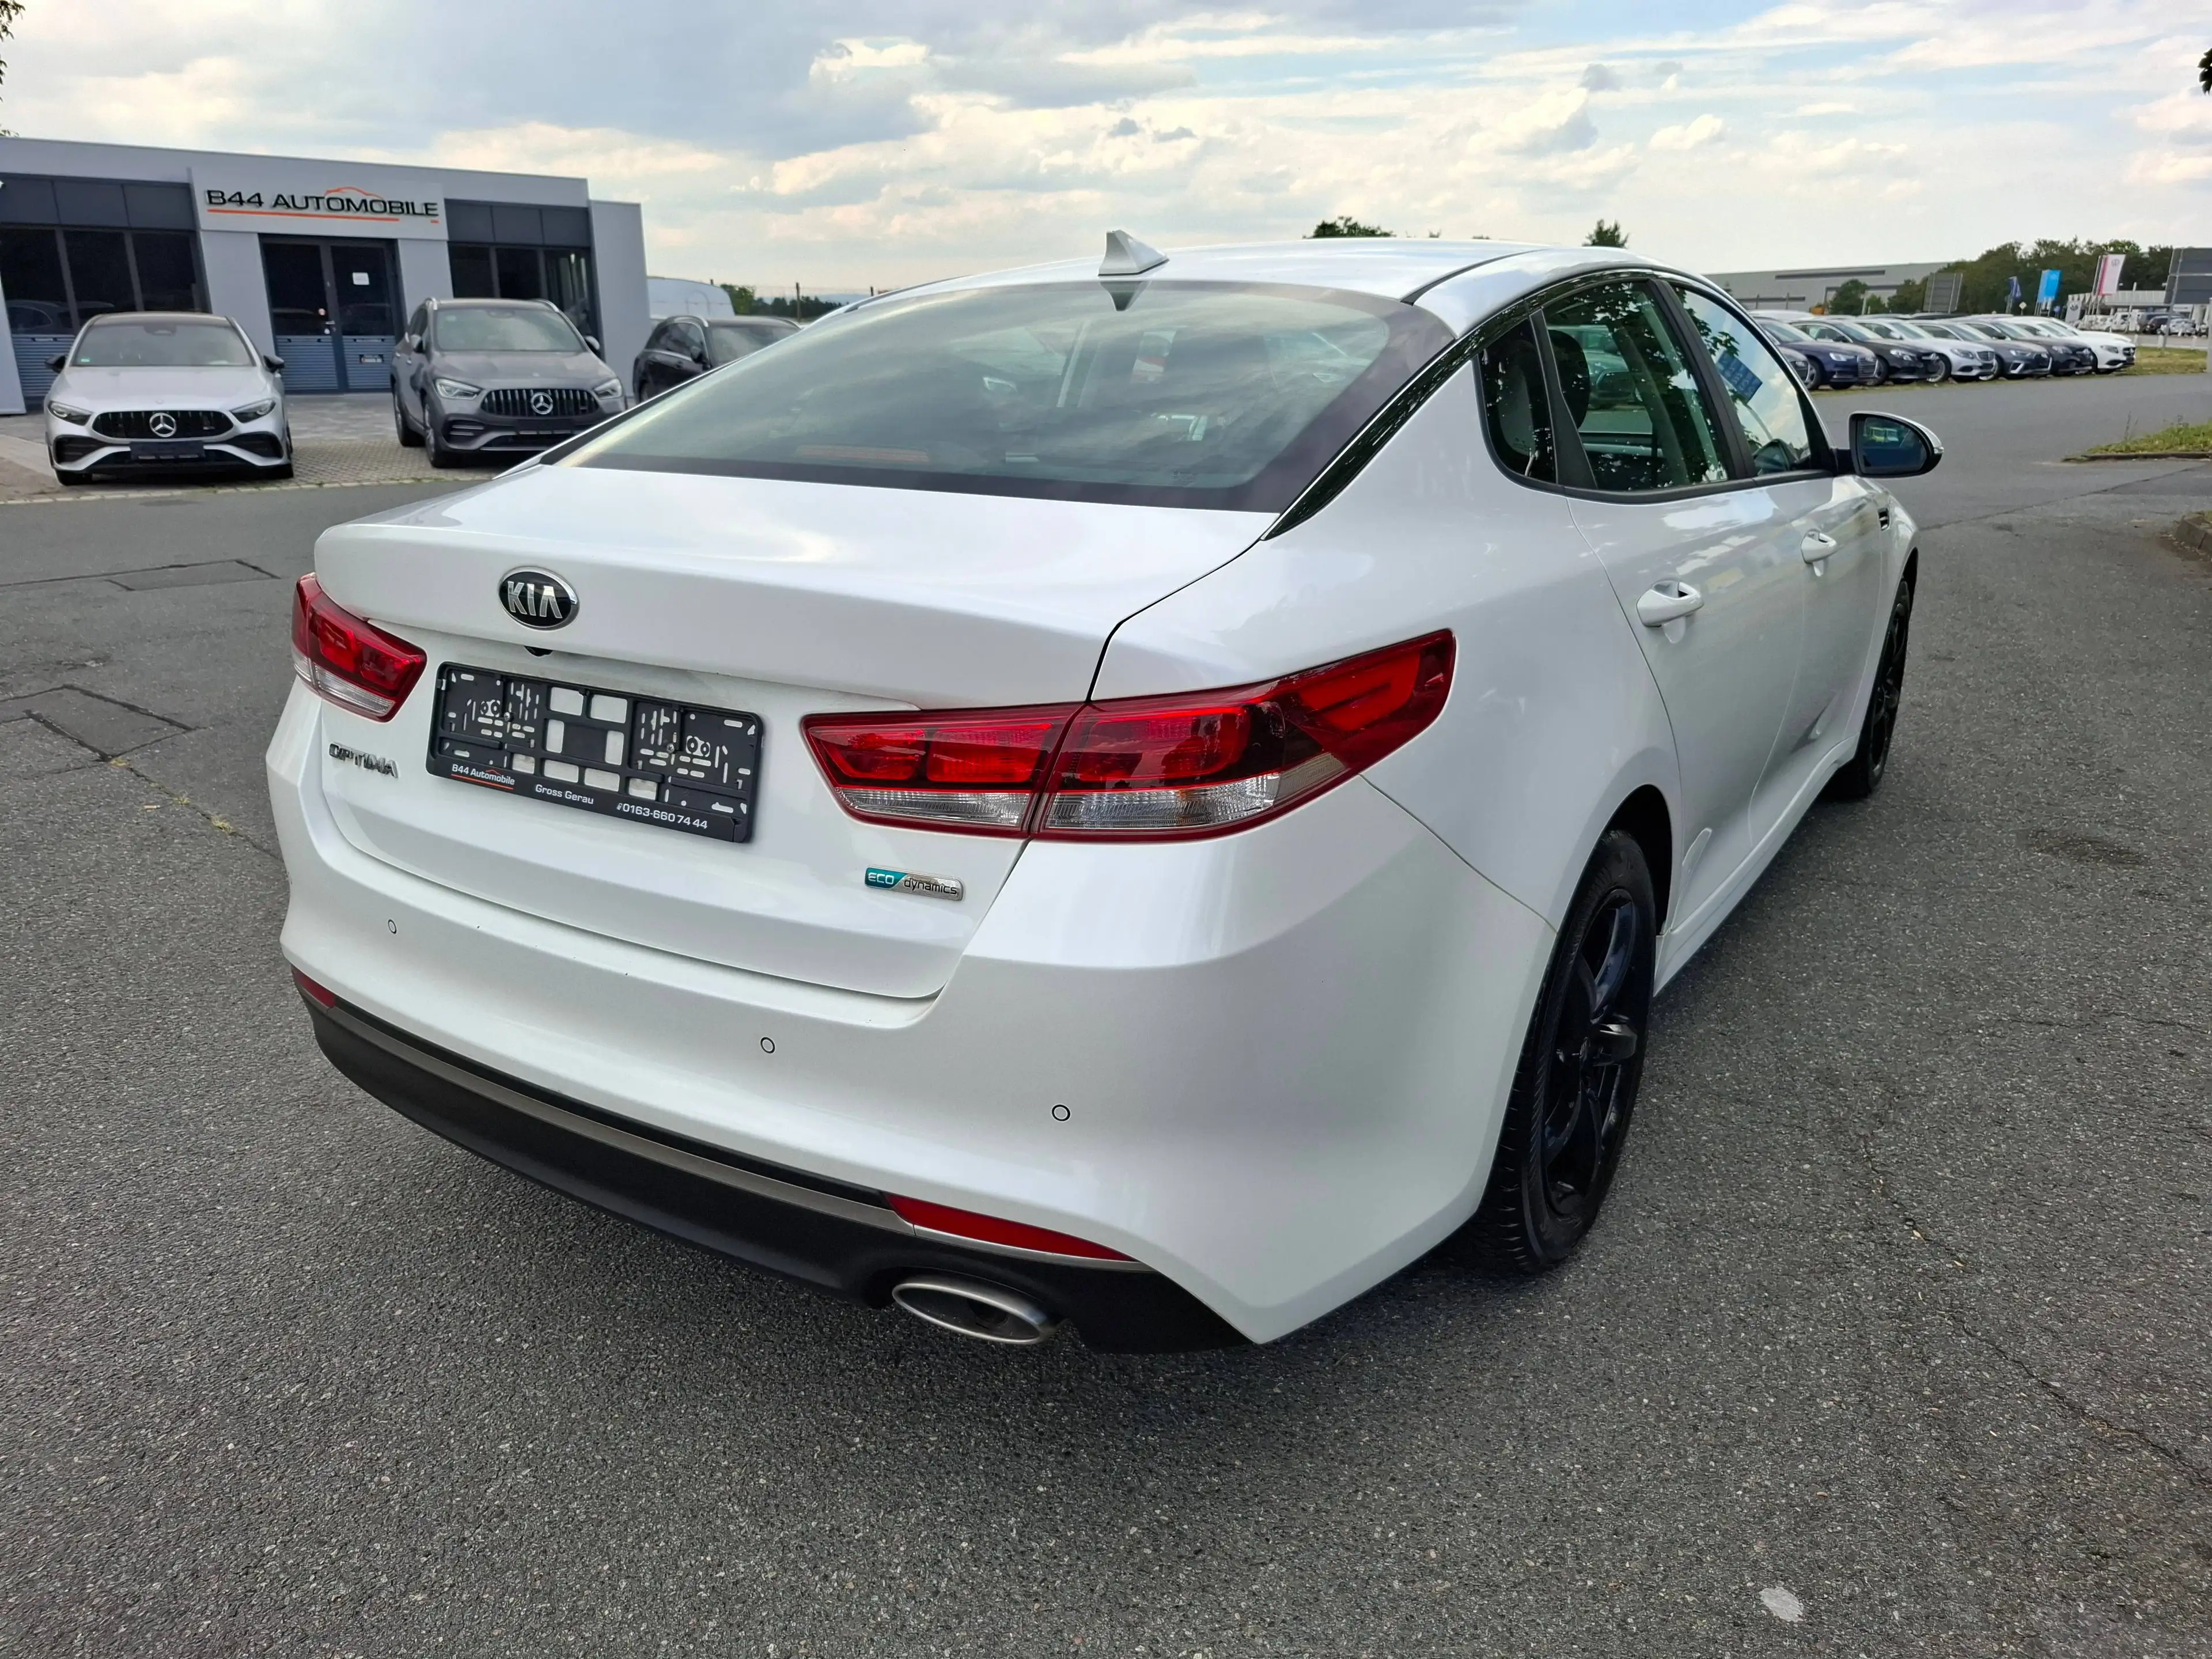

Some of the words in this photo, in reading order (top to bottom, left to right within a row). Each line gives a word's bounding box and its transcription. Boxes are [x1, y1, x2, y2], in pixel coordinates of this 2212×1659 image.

[207, 190, 264, 207] B44
[272, 194, 439, 217] AUTOMOBILE
[507, 580, 563, 618] KIA
[452, 764, 469, 774] B44
[470, 768, 516, 786] Automobile
[535, 784, 563, 798] Gross
[565, 790, 594, 804] Gerau
[868, 872, 894, 884] ECO
[904, 878, 957, 895] dynamics
